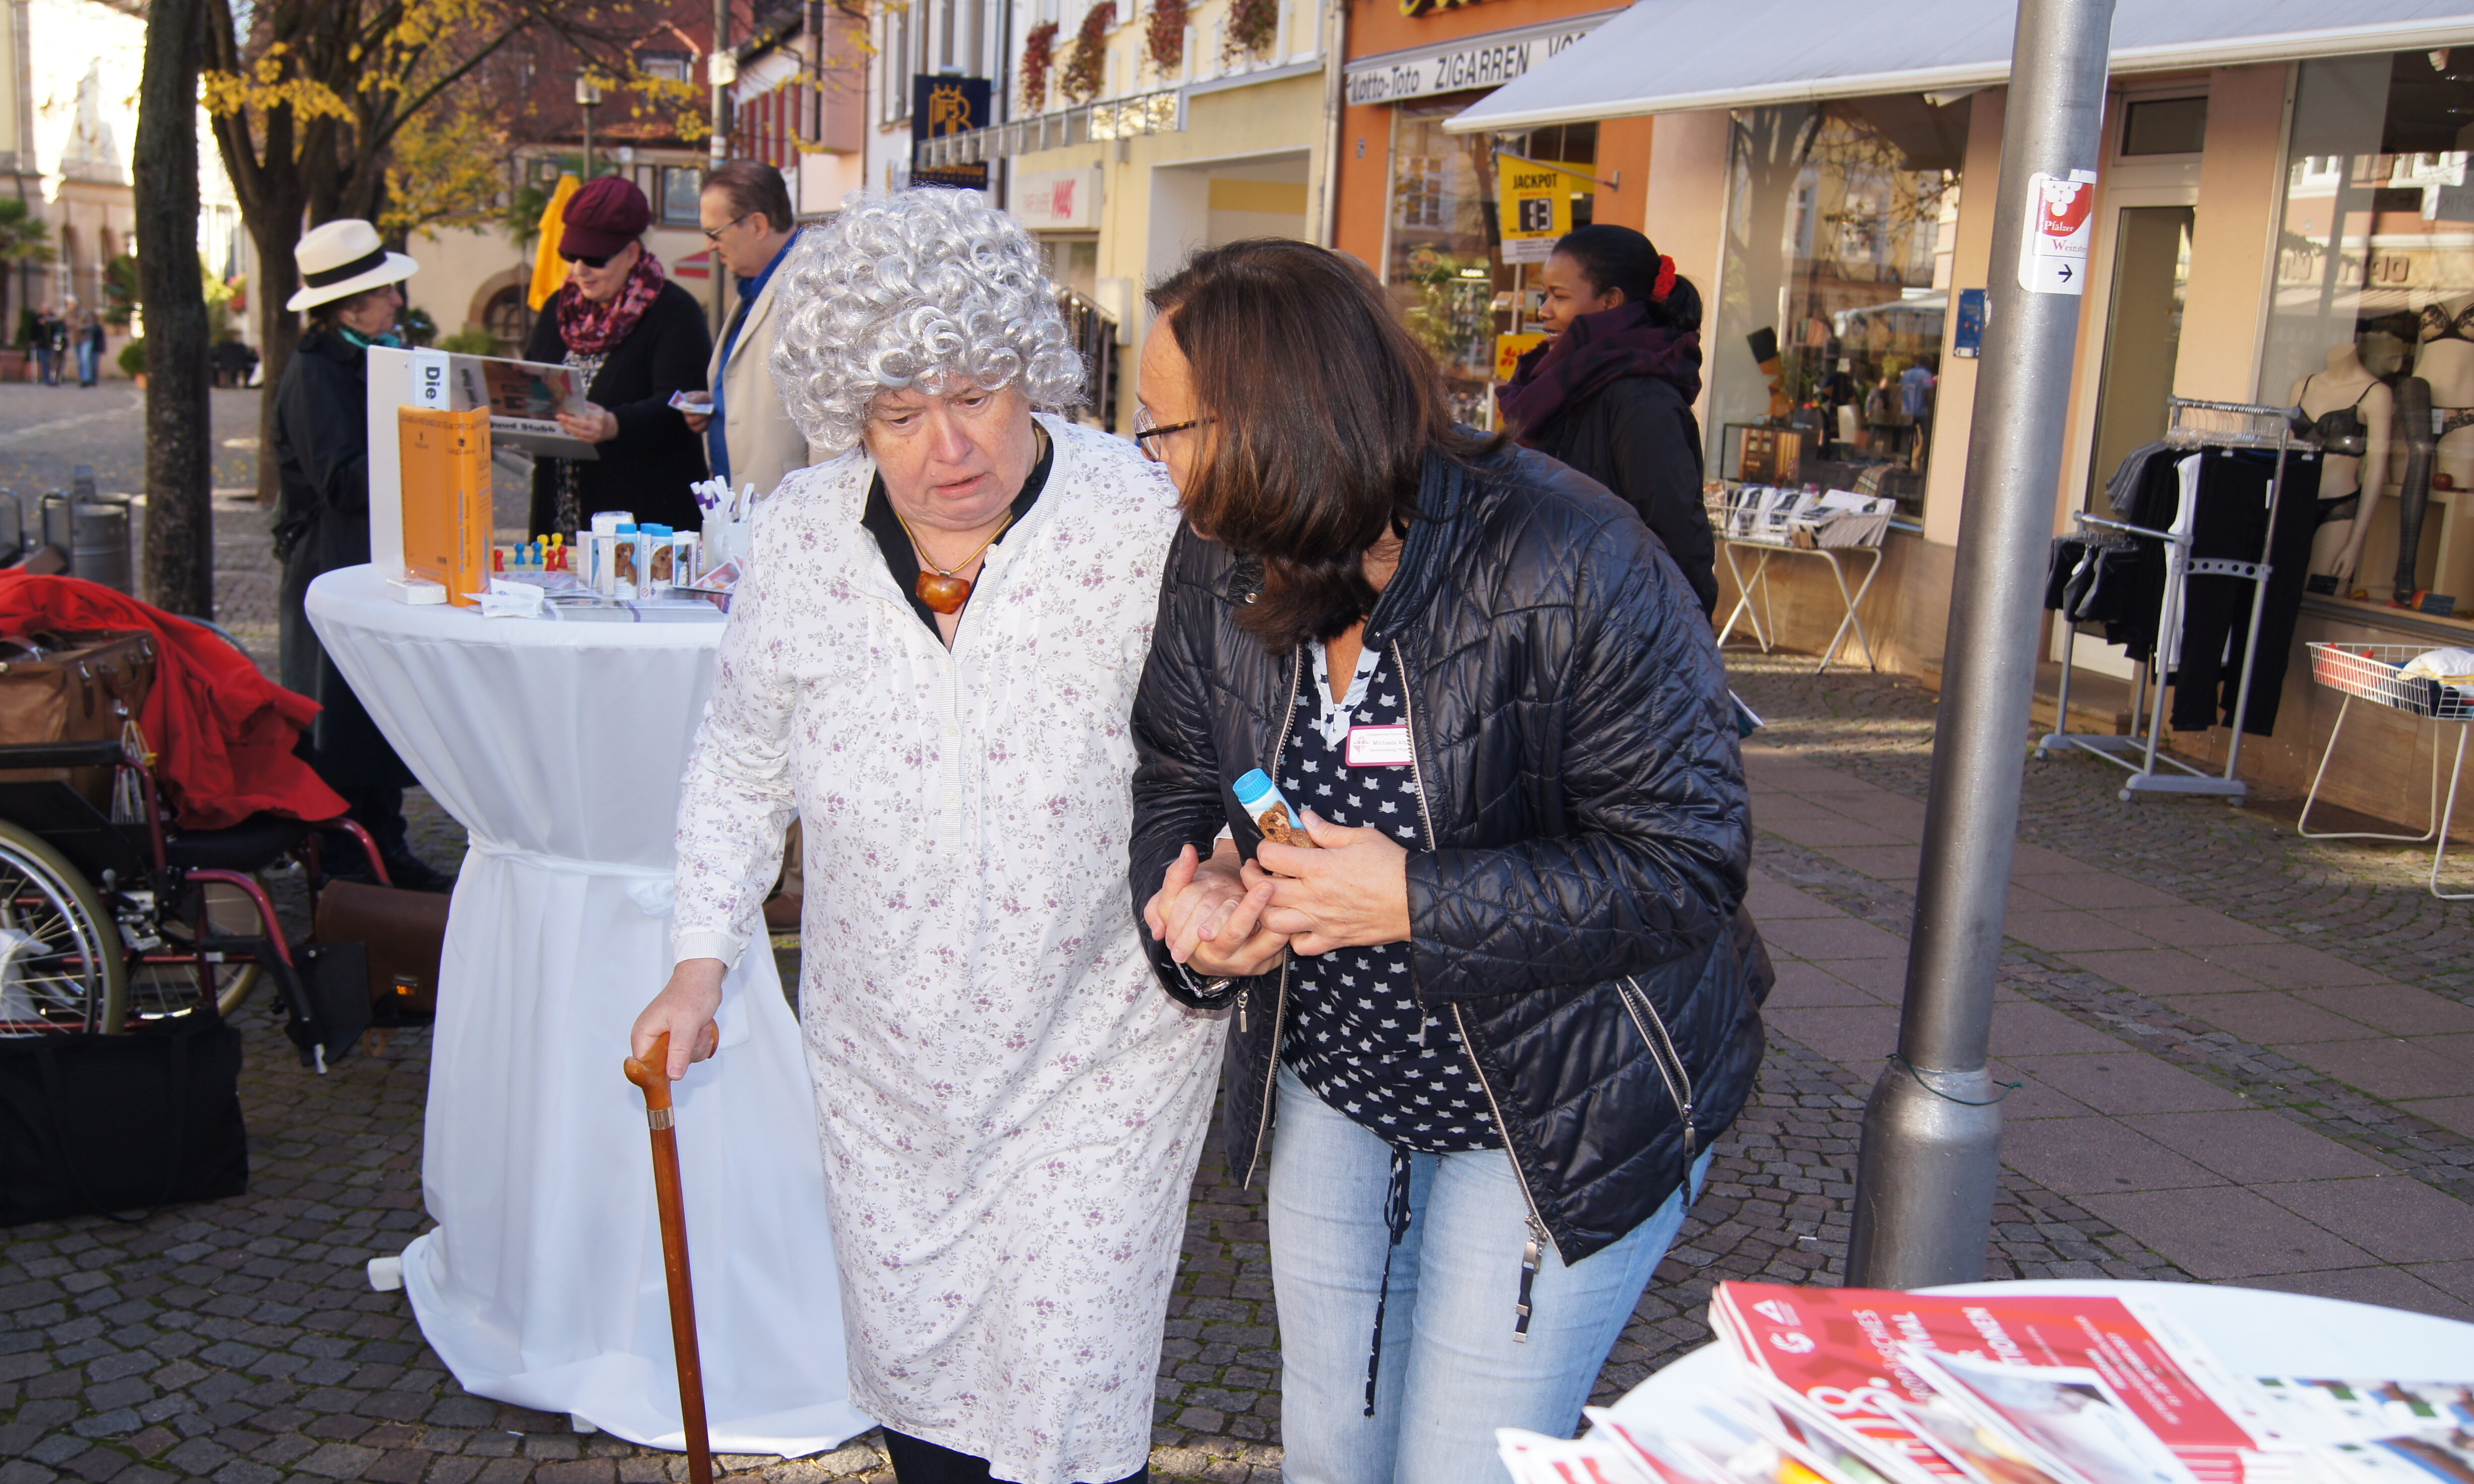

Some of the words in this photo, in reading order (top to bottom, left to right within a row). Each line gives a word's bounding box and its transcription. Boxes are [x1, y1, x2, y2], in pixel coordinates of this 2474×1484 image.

[1350, 66, 1420, 102] Lotto-Toto
[1435, 42, 1530, 89] ZIGARREN
[1514, 173, 1557, 189] JACKPOT
[2043, 220, 2074, 232] Pfälzer
[426, 366, 440, 400] Die
